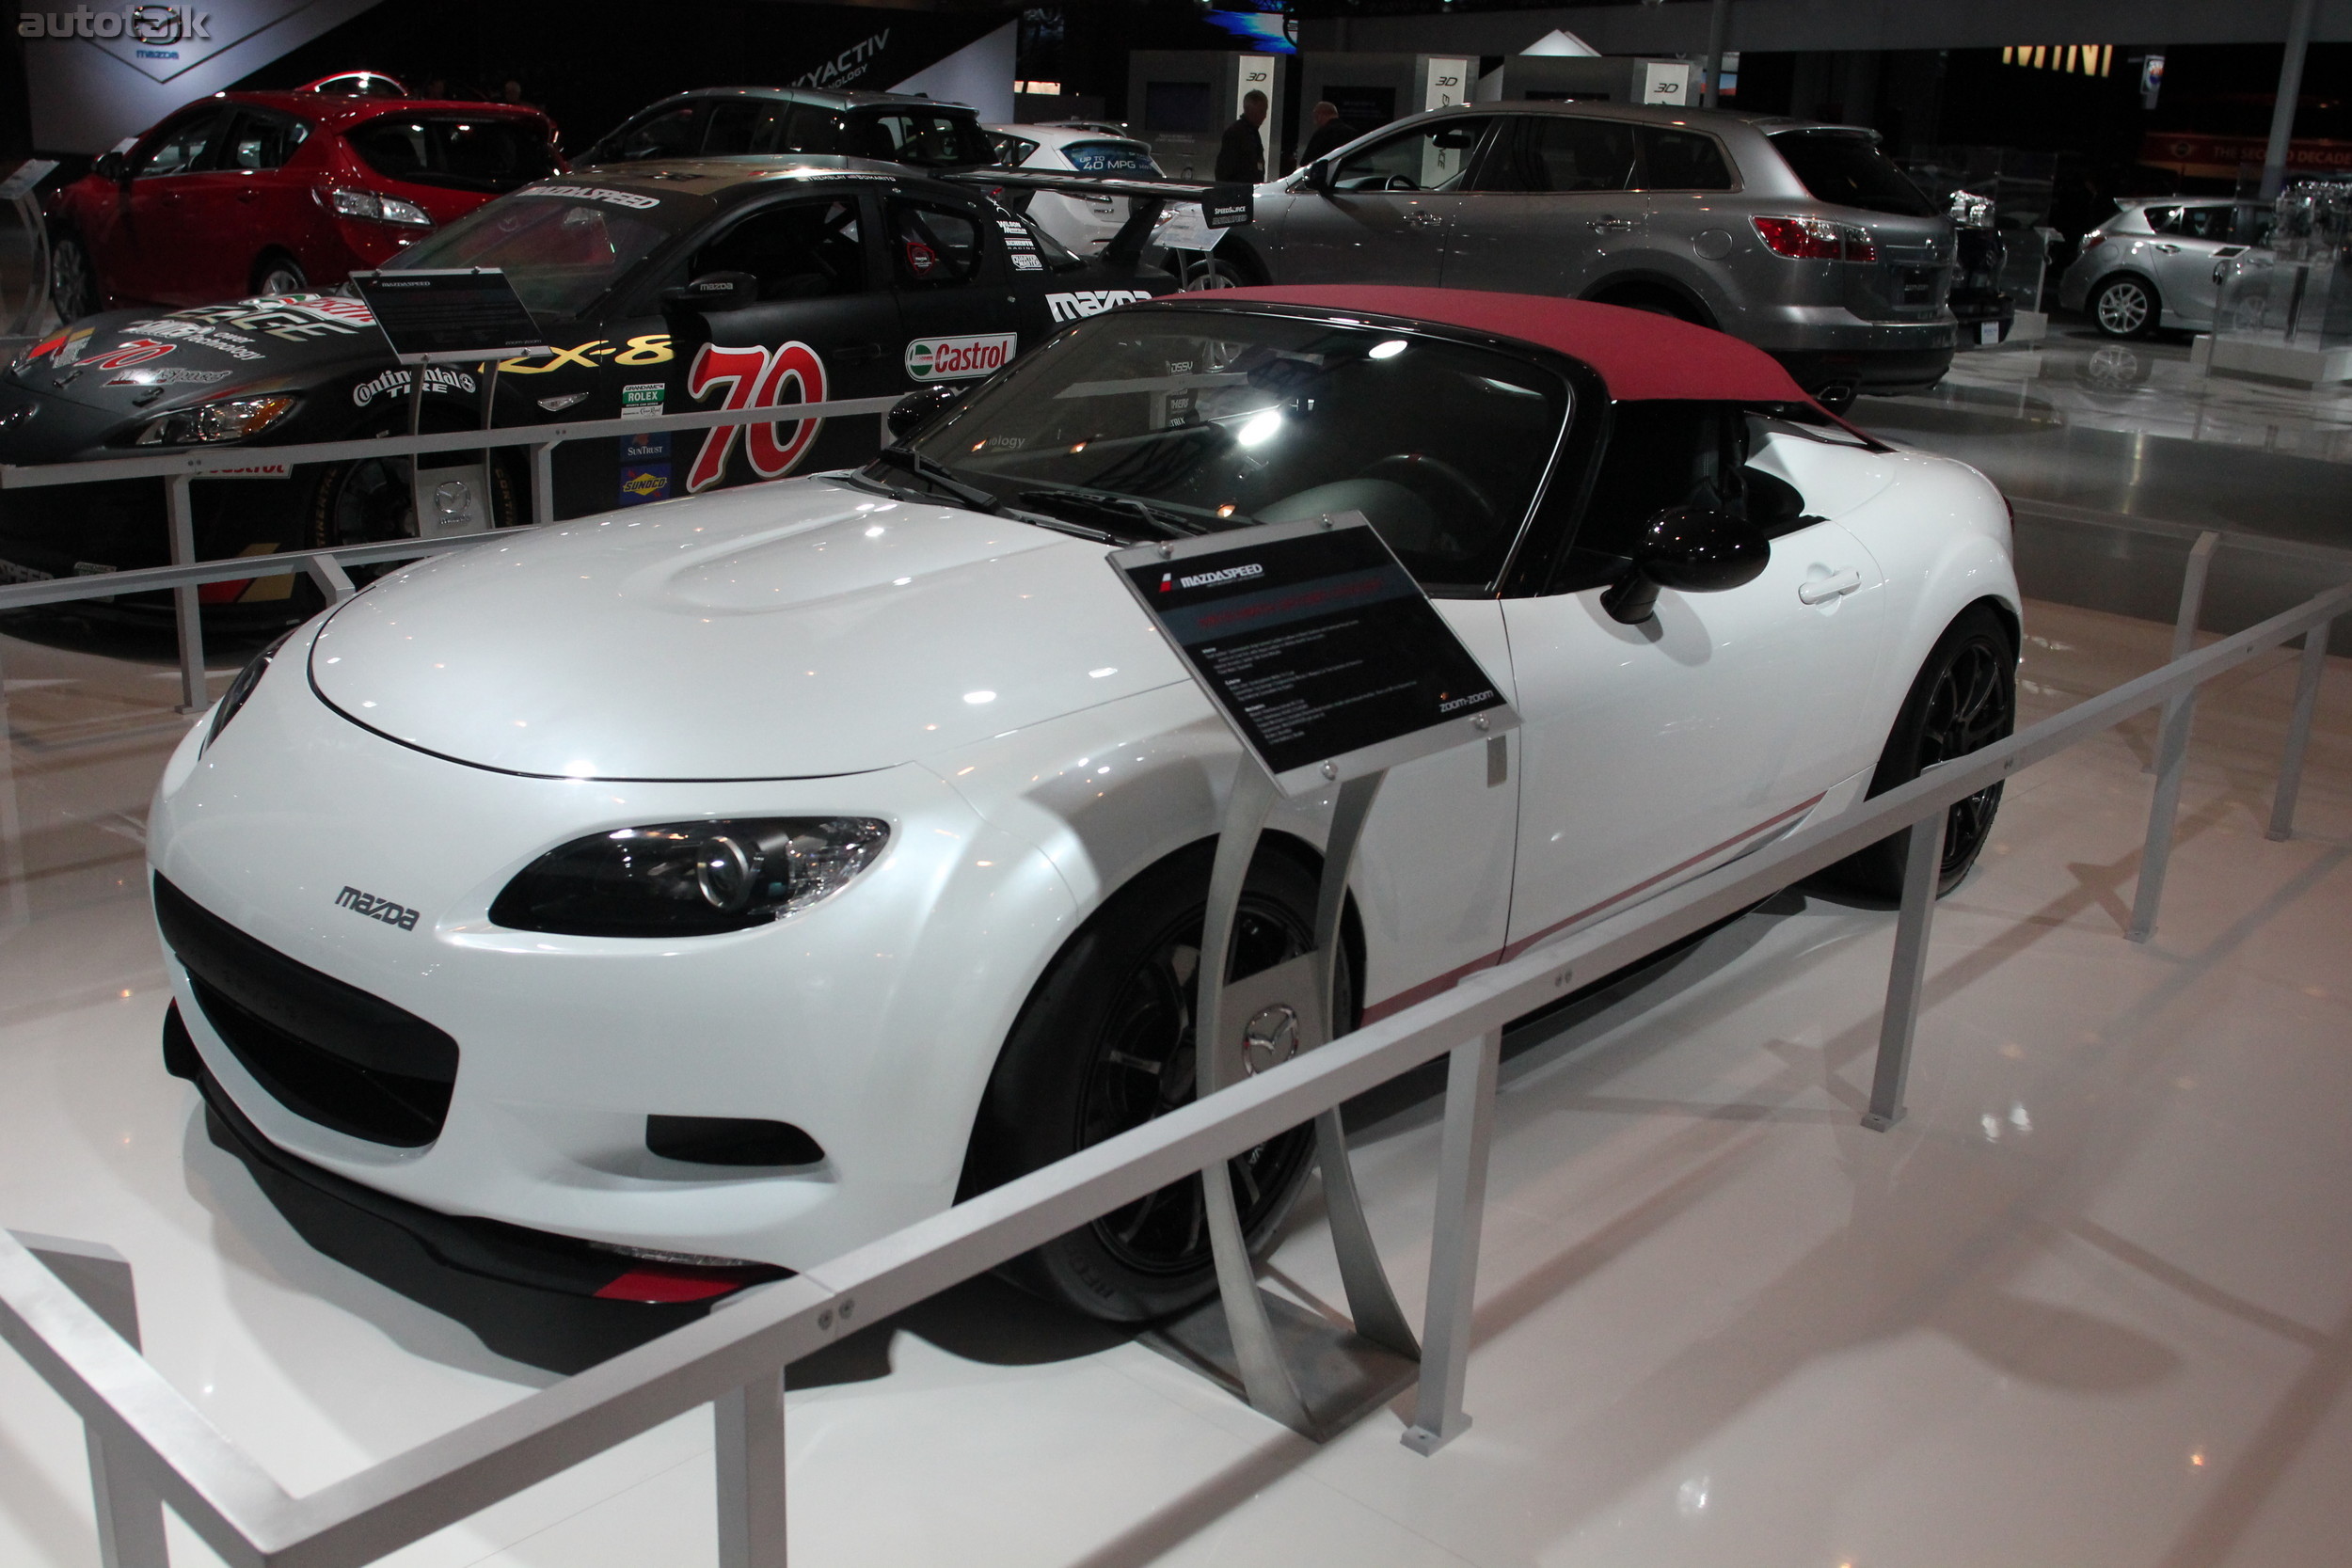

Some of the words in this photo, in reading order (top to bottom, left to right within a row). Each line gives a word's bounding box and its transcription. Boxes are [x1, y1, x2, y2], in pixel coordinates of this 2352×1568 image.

[1246, 72, 1267, 82] 3D
[1436, 76, 1458, 87] 3D
[1654, 83, 1680, 93] 3D
[1083, 161, 1104, 170] 40
[700, 282, 733, 291] mazda
[73, 339, 177, 370] 70
[935, 341, 1008, 373] Castrol
[353, 368, 462, 406] Continntal
[628, 391, 658, 402] ROLEX
[687, 341, 828, 494] 70
[624, 477, 667, 492] SUNOCO
[1180, 563, 1263, 588] MAZDASPEED
[1439, 689, 1494, 713] zoom-zoom
[334, 885, 420, 932] mazda
